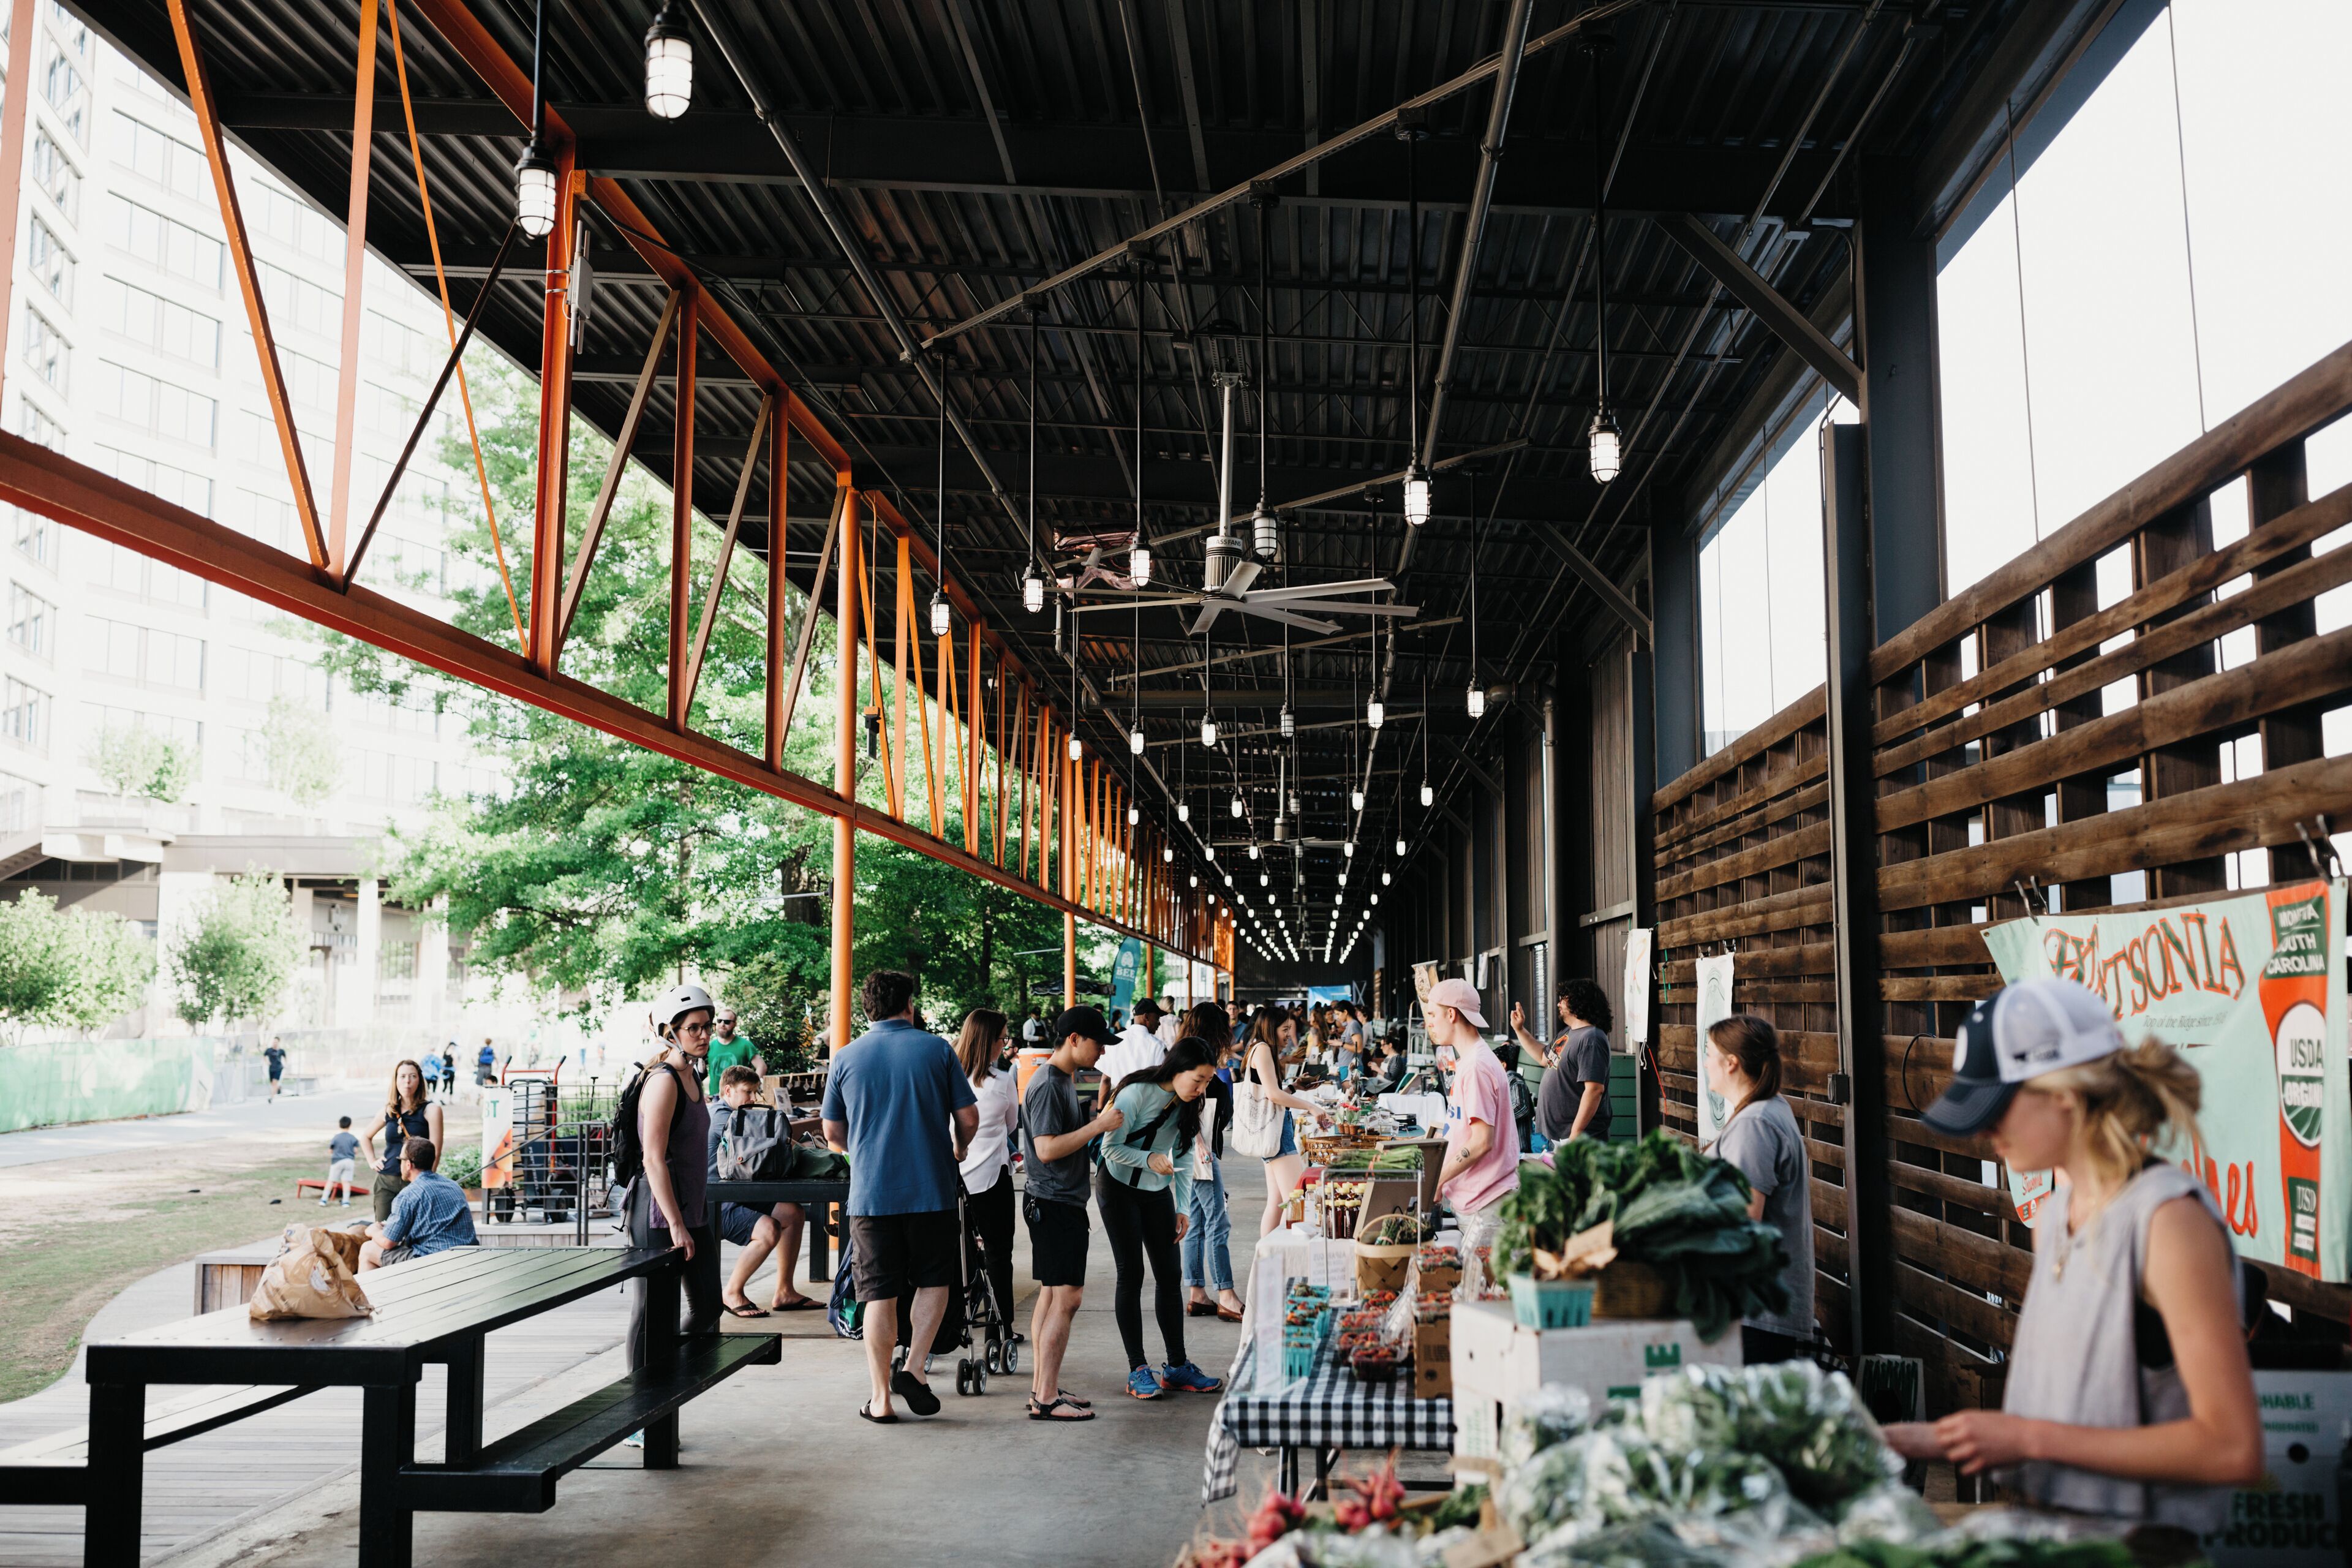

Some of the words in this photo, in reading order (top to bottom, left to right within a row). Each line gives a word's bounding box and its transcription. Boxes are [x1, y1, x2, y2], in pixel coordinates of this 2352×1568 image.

[1116, 966, 1136, 979] BEE
[2267, 954, 2326, 974] CAROLINA
[2143, 1015, 2157, 1031] Top
[2165, 1014, 2177, 1028] the
[2177, 1015, 2197, 1031] Ridge
[2196, 1014, 2214, 1028] since
[2290, 1038, 2324, 1069] USDA
[2232, 1491, 2326, 1520] FRESH
